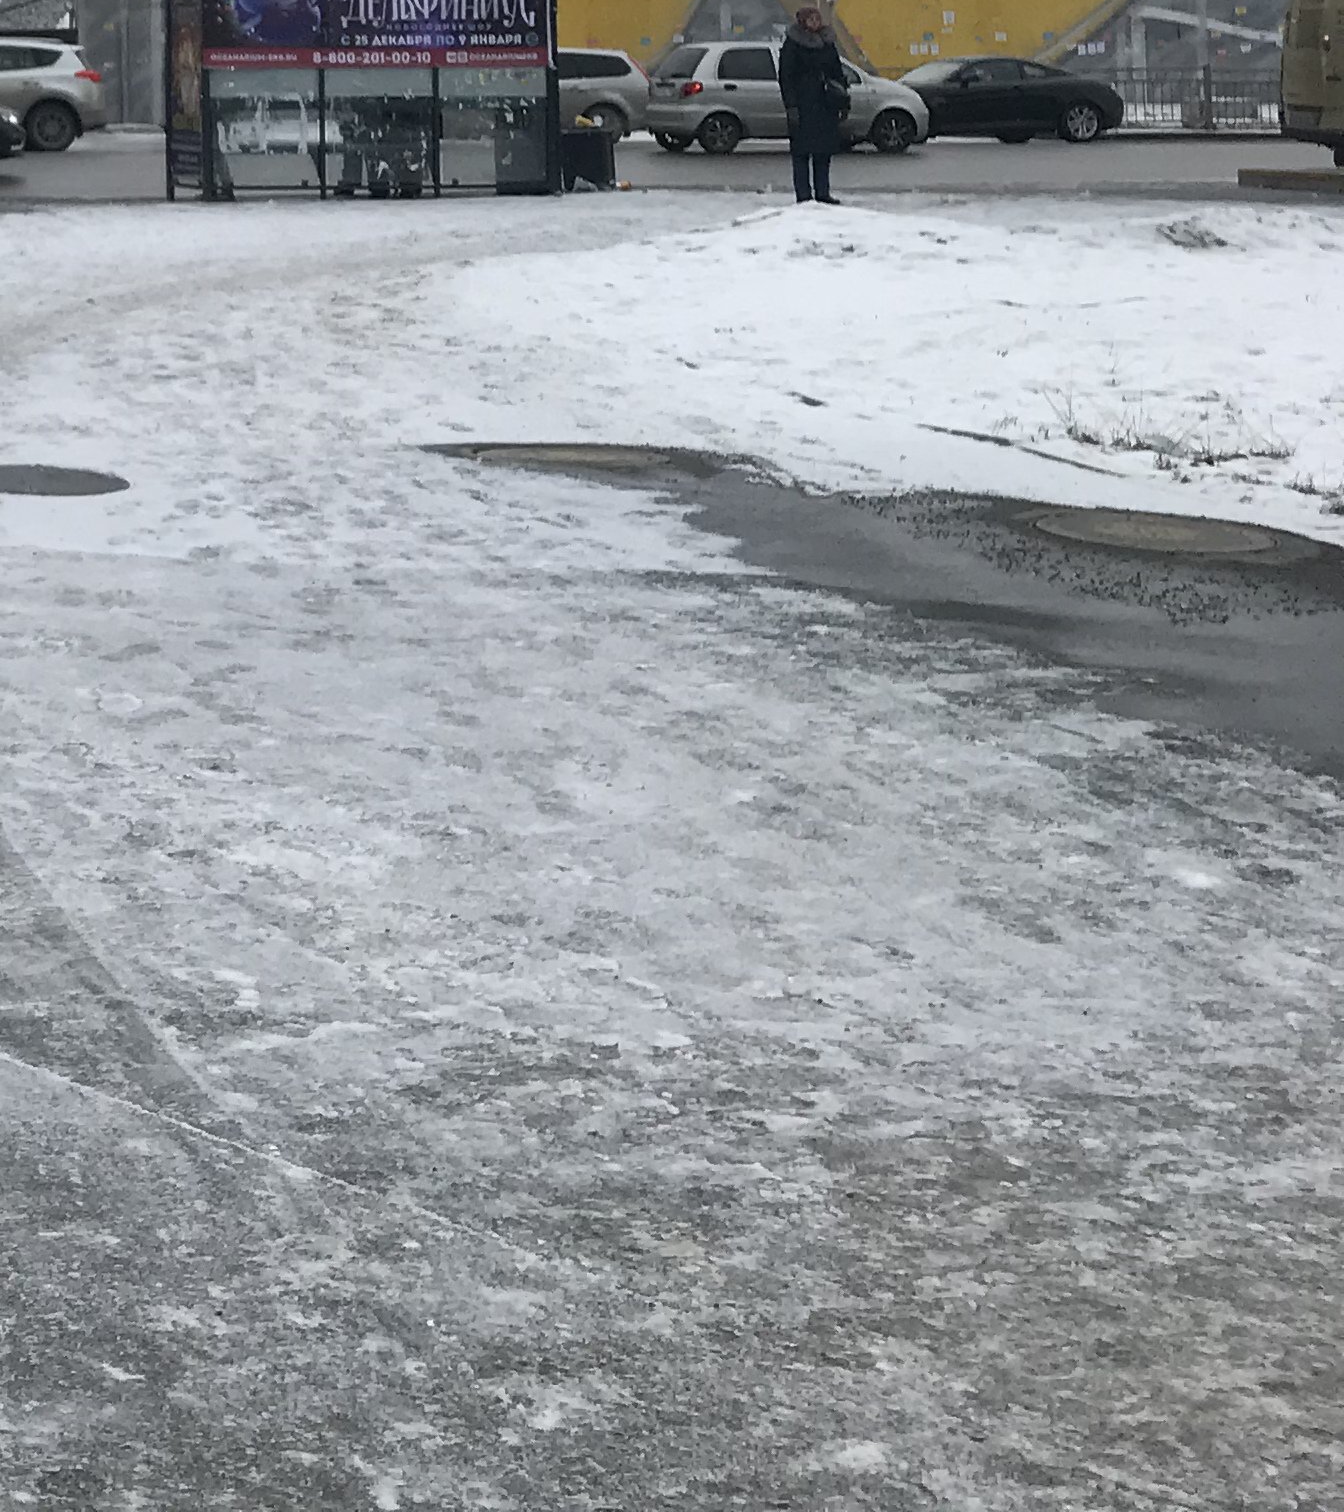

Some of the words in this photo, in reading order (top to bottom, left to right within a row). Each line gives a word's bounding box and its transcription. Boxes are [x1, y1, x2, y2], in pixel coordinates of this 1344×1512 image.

[372, 34, 432, 46] ДЕКАБРЯ
[436, 33, 455, 46] ПО
[470, 32, 522, 45] ЯНВАРЯ
[313, 50, 431, 64] 8-800-201-00-10
